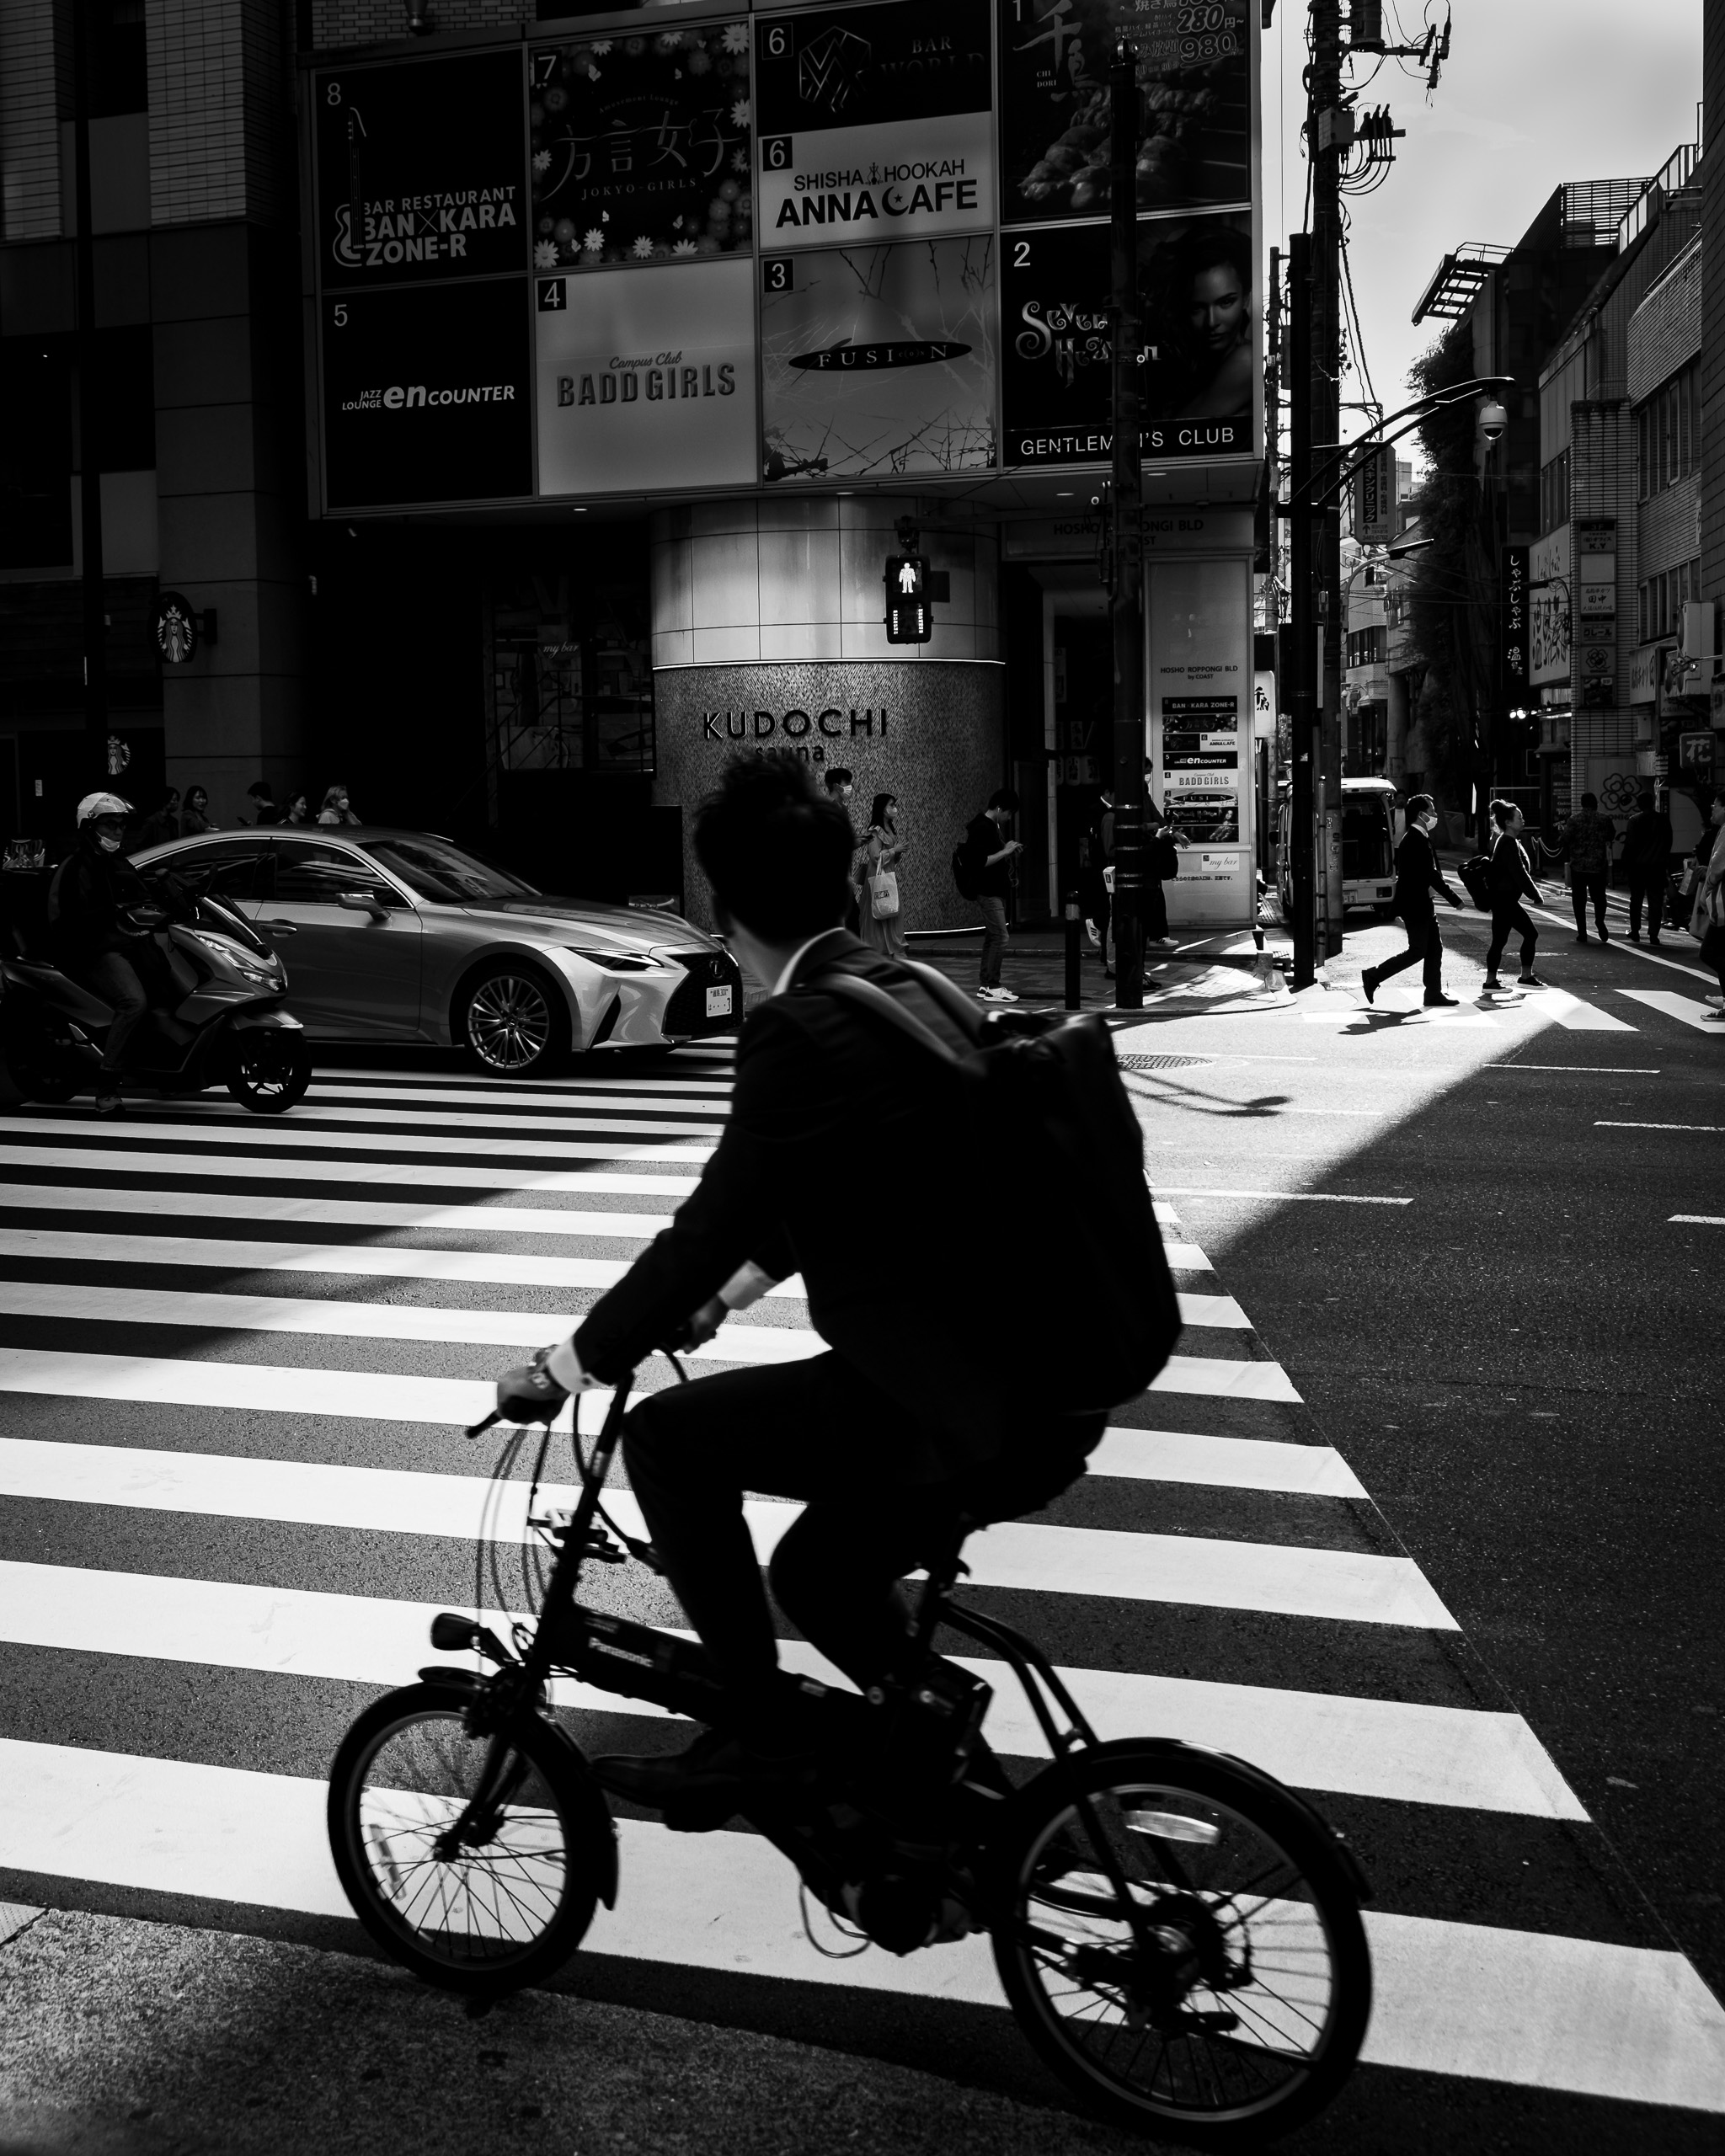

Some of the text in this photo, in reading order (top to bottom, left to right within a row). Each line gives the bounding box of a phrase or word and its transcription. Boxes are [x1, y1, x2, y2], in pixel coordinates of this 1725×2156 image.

[767, 27, 786, 56] 6
[911, 35, 952, 54] BAR
[538, 55, 557, 80] 7
[879, 54, 986, 77] WORLD
[1036, 70, 1051, 78] CHI
[327, 83, 341, 105] 8
[1036, 79, 1057, 88] DORI
[768, 140, 786, 168] 6
[793, 158, 966, 191] SHISHA HOOKAH
[364, 186, 515, 215] BAR RESTAURANT
[580, 177, 697, 202] JOKYO-GIRLS
[775, 179, 979, 229] ANNA CAFE
[365, 233, 467, 267] ZONE-R
[1013, 242, 1032, 267] 2
[771, 263, 786, 289] 3
[543, 281, 561, 308] 4
[334, 304, 349, 327] 5
[609, 350, 683, 371] Campus Club
[360, 389, 382, 399] JAZZ
[557, 362, 736, 408] BADD GIRLS
[342, 398, 382, 411] LOUNGE
[1179, 427, 1235, 446] CLUB
[1054, 524, 1101, 536] HOSHO
[1178, 519, 1204, 531] BLD
[1509, 554, 1521, 630] しゃぶしゃぶ
[542, 641, 580, 659] my bar
[703, 708, 887, 739] KUDOCHI
[1686, 739, 1712, 762] 花
[1179, 776, 1229, 786] BADD GIRLS
[1210, 857, 1237, 870] my bar
[588, 1636, 654, 1668] Panasonic
